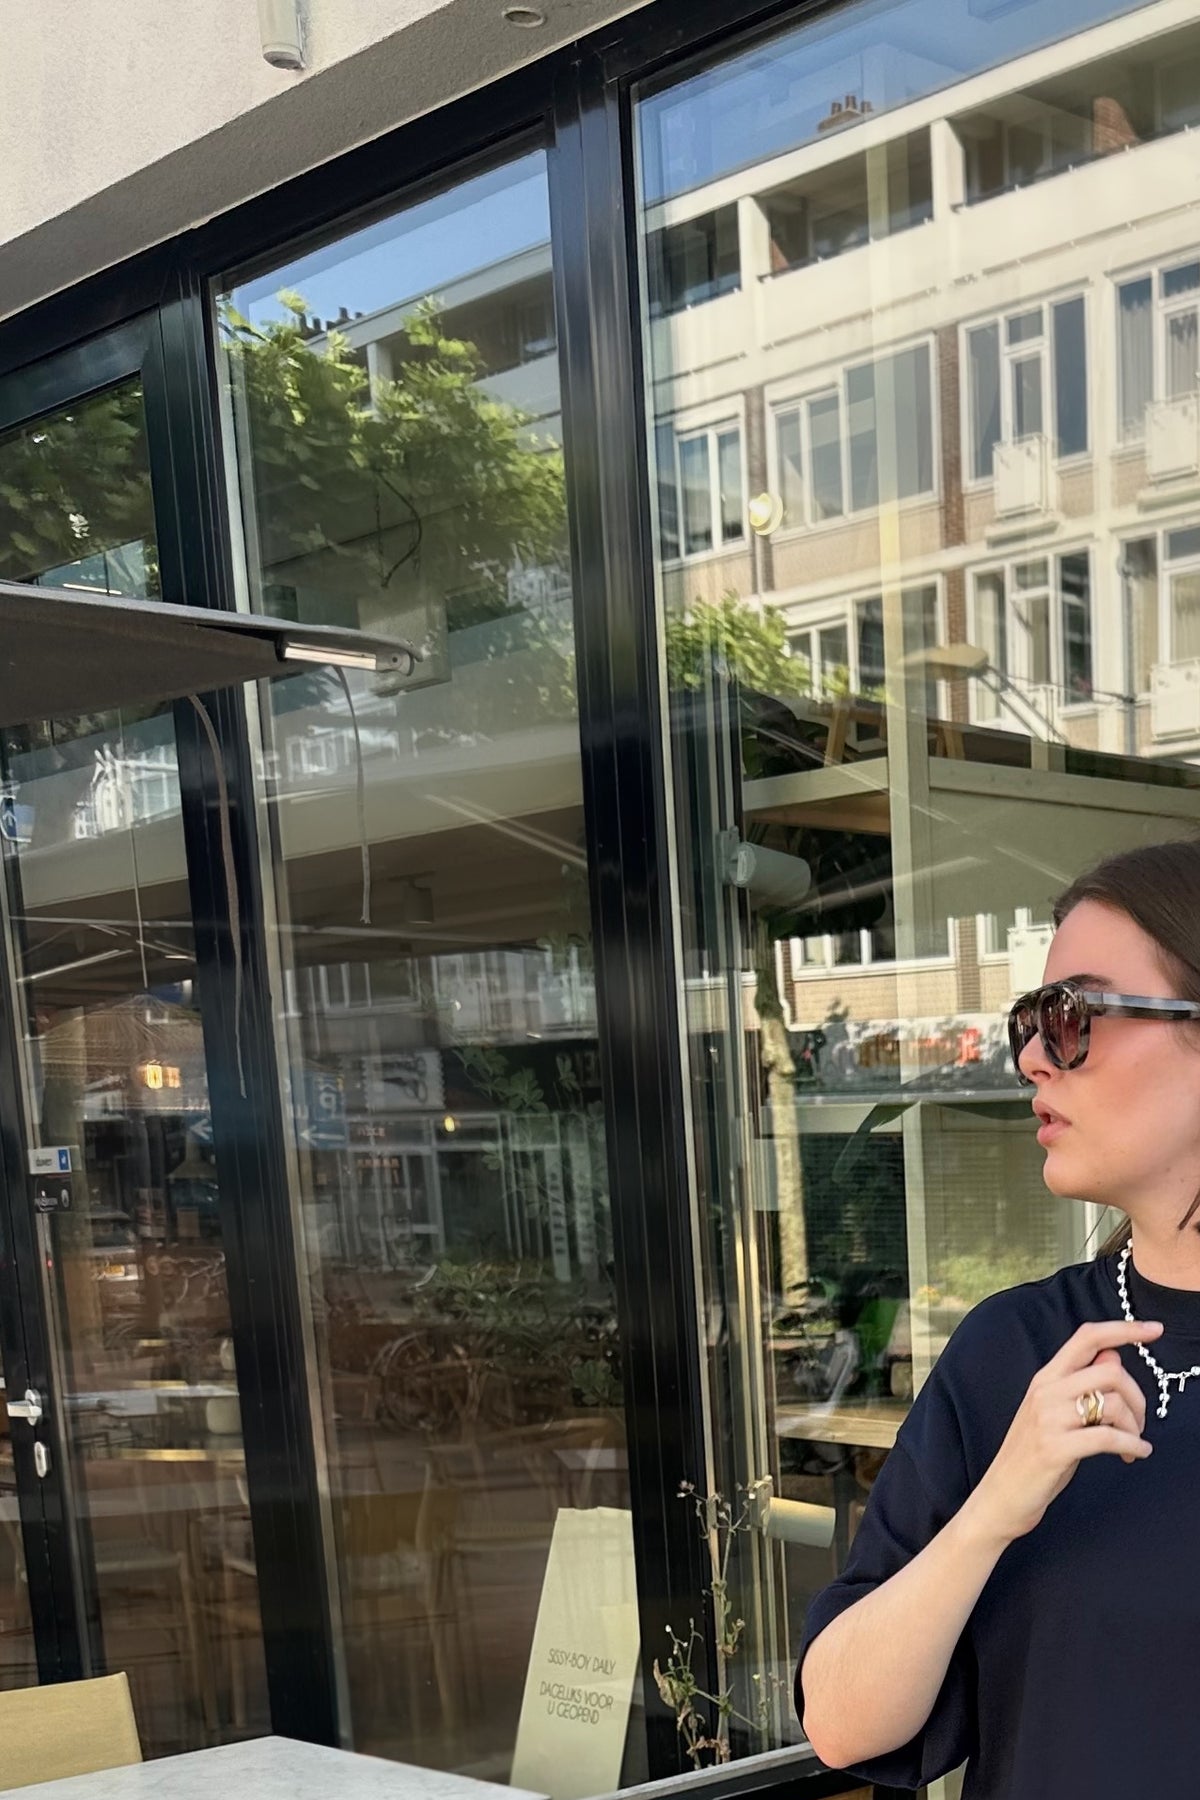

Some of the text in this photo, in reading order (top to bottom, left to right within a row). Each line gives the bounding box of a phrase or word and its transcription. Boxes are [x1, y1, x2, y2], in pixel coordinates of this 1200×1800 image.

[592, 1656, 616, 1675] DAILY
[547, 1700, 556, 1715] U
[583, 1690, 614, 1710] VOOR
